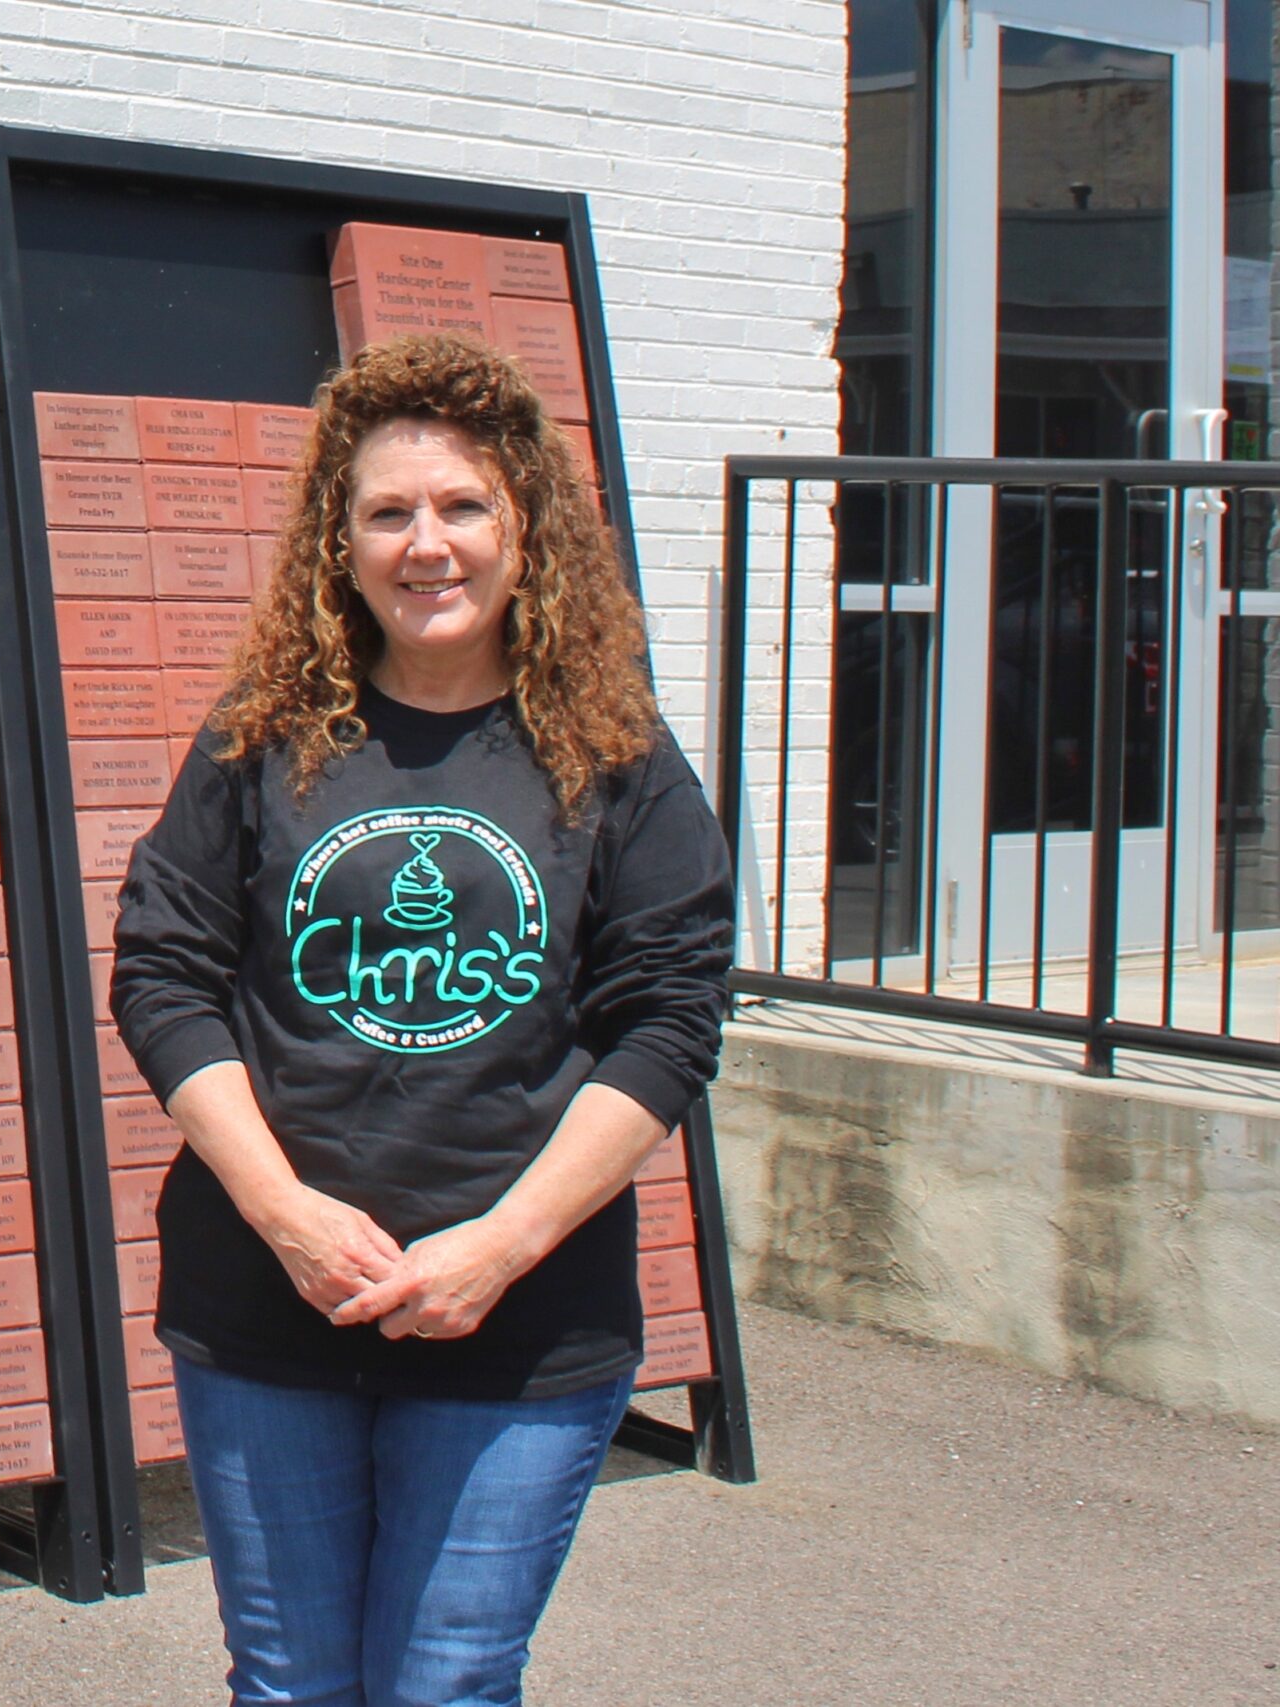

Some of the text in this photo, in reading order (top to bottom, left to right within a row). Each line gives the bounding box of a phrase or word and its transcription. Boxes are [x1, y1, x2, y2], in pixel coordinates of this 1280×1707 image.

[299, 815, 537, 906] Where hot coffee meets cool friends
[292, 916, 543, 1004] Chris's
[352, 1014, 396, 1044] Coffee
[416, 1016, 485, 1045] Custard
